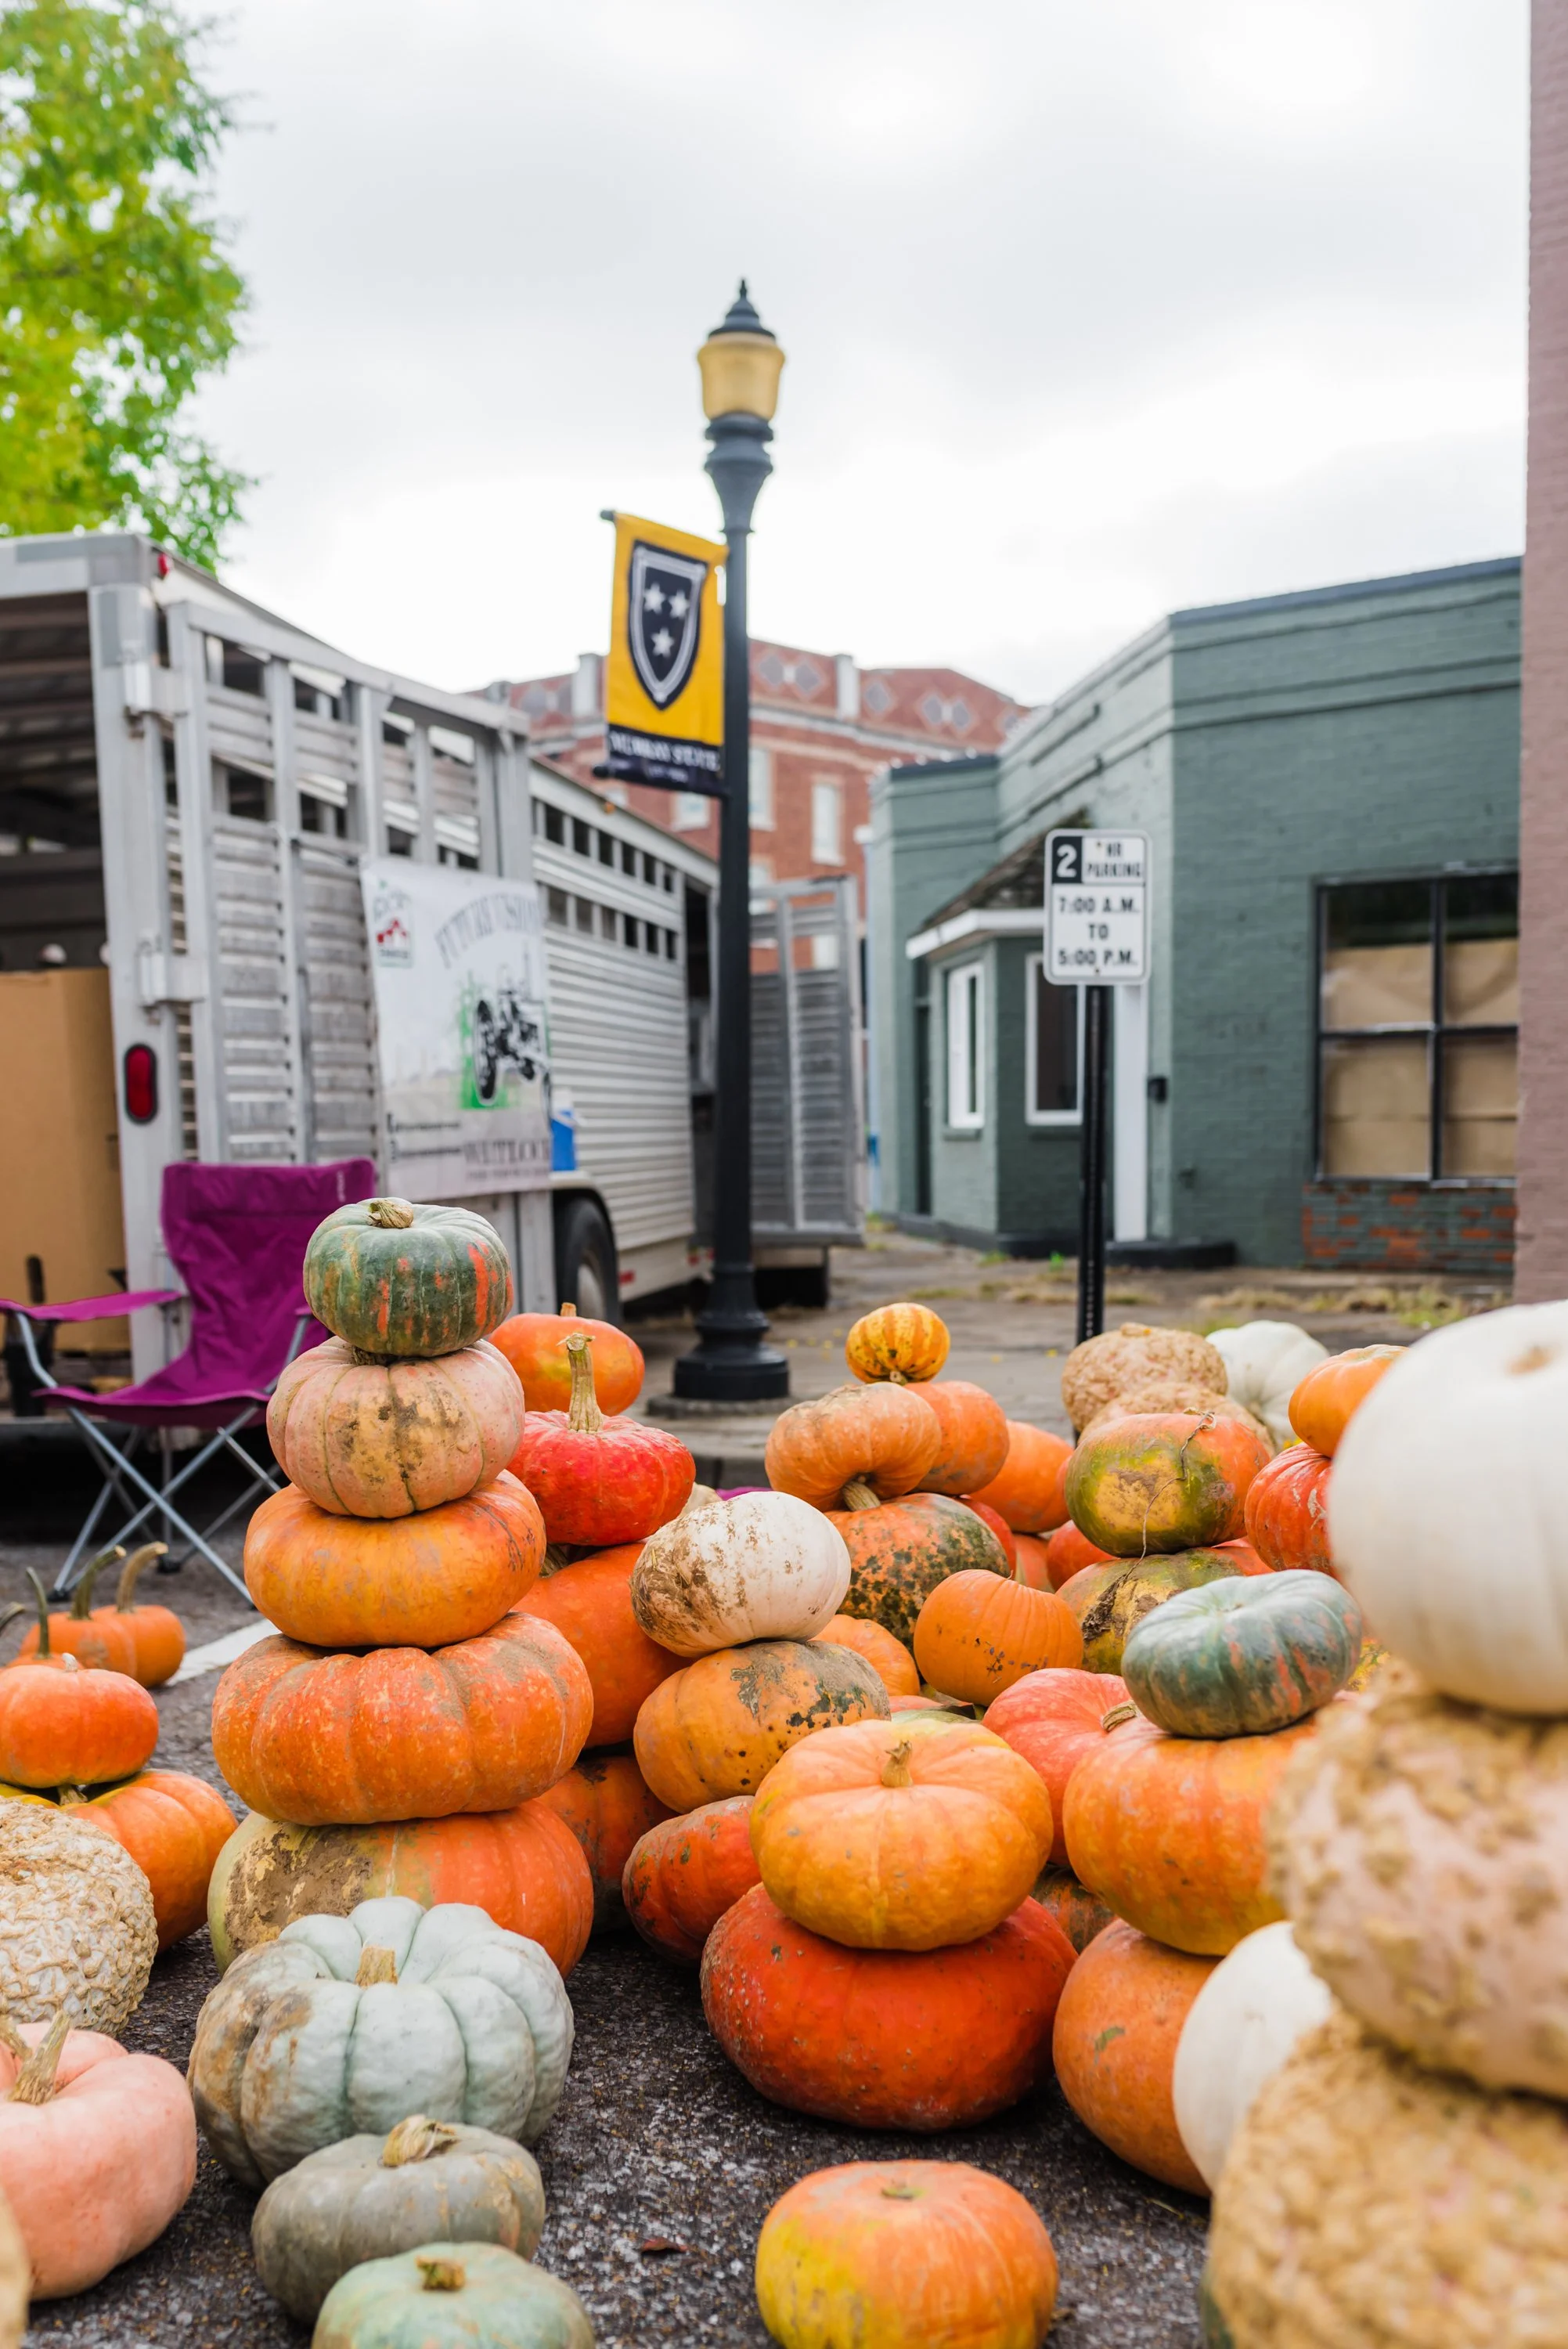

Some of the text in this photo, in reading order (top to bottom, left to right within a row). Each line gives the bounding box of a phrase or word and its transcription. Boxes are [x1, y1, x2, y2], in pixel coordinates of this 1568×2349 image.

[1057, 844, 1077, 878] 2
[1087, 862, 1141, 878] PARKING
[1059, 897, 1140, 913] 7:00 A.M.
[1088, 924, 1109, 940] TO
[1058, 950, 1138, 965] 5:00 P.M.
